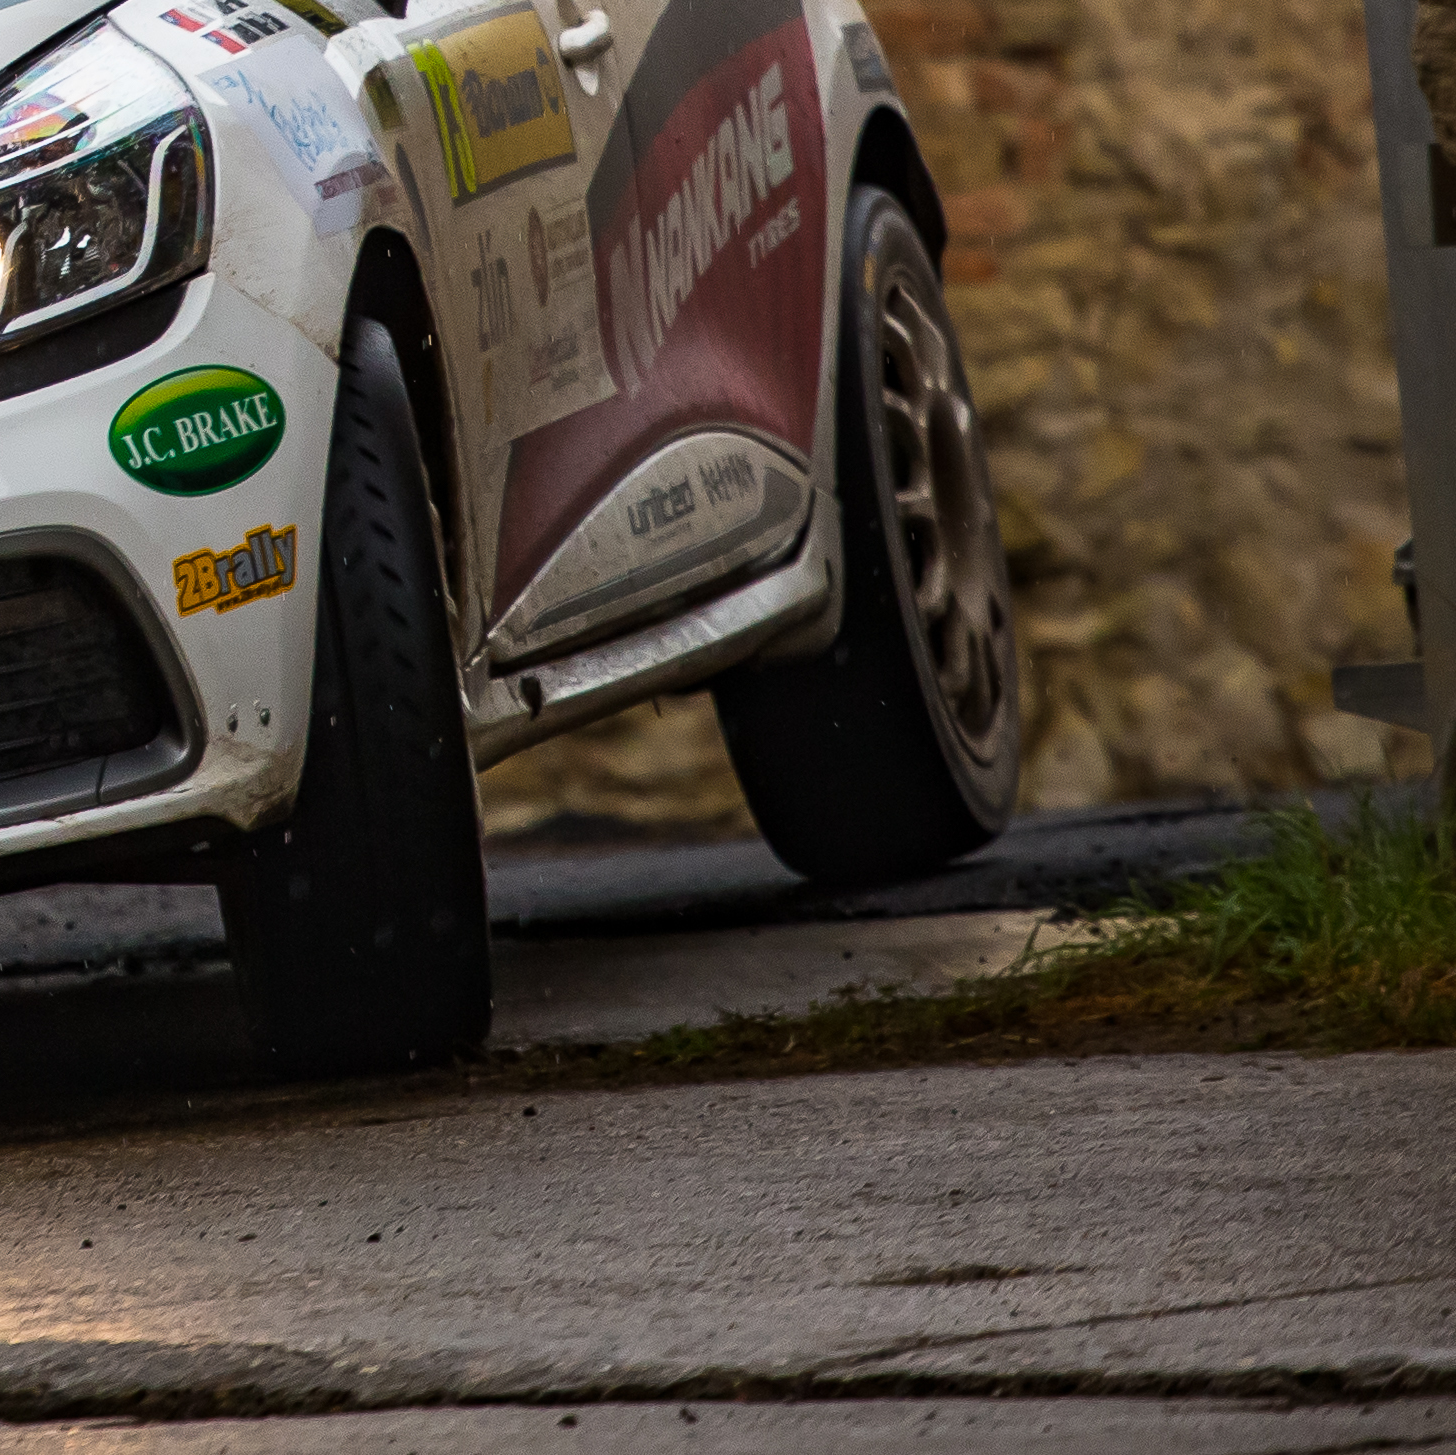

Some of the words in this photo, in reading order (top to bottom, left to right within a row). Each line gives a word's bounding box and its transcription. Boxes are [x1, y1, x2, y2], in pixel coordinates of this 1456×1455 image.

[645, 60, 795, 348] NANKANG
[120, 426, 177, 470] J.C.
[173, 392, 278, 454] BRAKE
[173, 528, 298, 615] 2Brally
